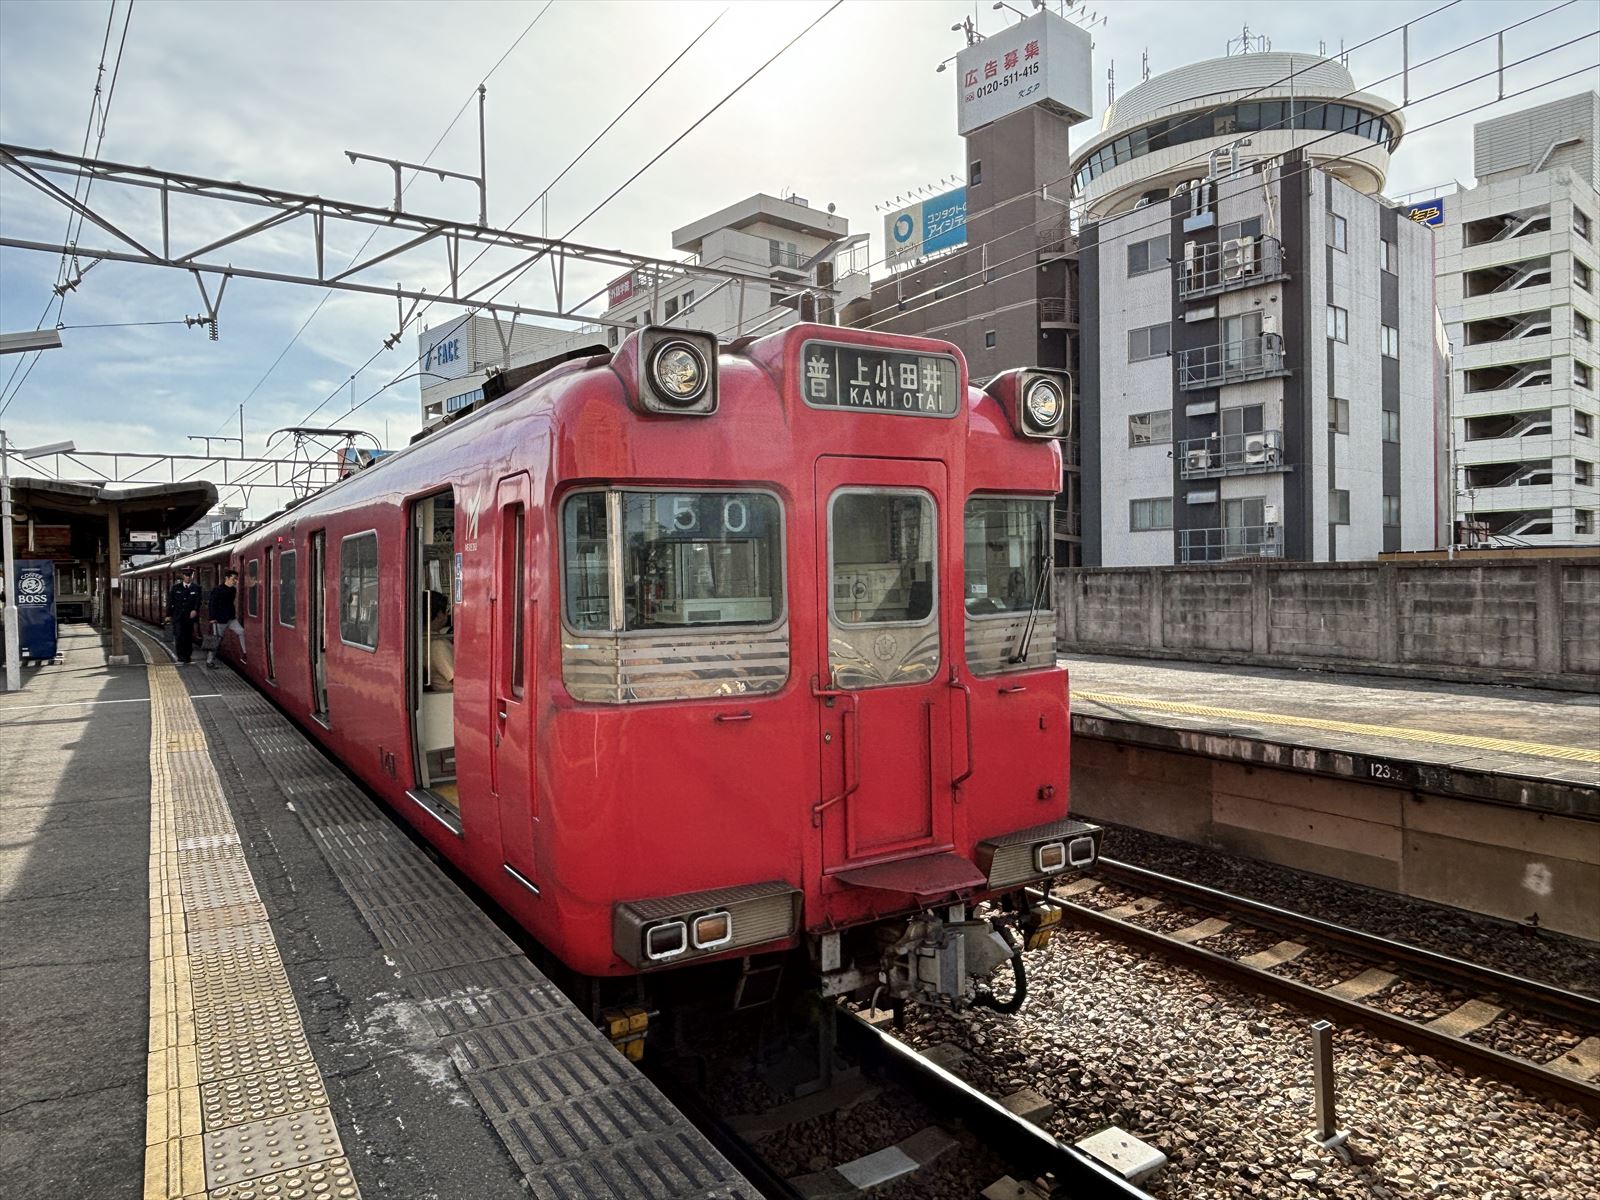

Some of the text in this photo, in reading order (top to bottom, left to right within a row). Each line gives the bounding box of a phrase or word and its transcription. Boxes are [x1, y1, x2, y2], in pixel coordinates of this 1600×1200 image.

[964, 40, 1040, 88] 広告募集
[976, 62, 1040, 99] 0120-511-415
[807, 356, 831, 398] 普
[849, 357, 941, 393] 上小田井
[850, 387, 942, 411] KAMI OTAI
[18, 594, 48, 604] BOSS
